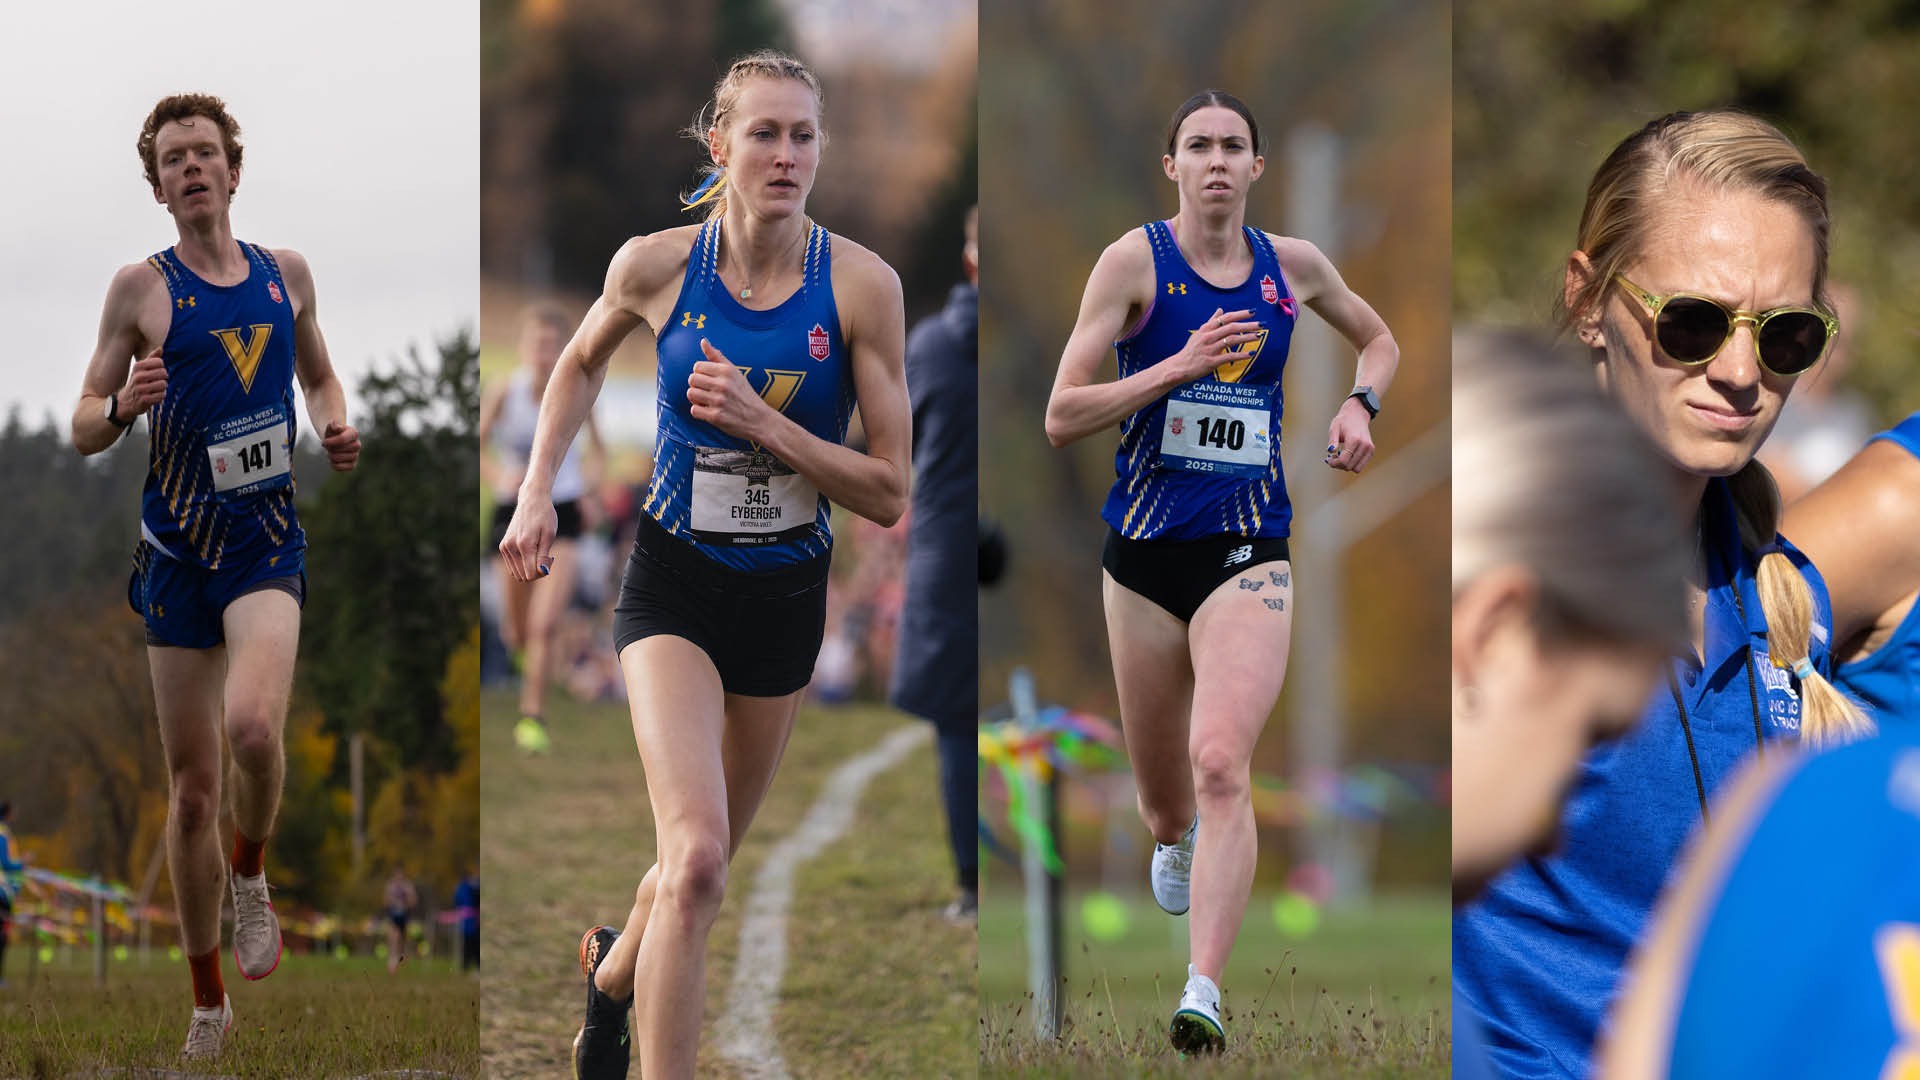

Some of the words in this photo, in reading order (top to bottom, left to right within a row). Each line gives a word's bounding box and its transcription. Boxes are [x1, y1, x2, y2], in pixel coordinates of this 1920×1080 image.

[811, 345, 829, 355] WEST
[208, 323, 273, 395] V
[1180, 389, 1193, 398] XC
[1195, 392, 1265, 406] CHAMPIONSHIPS
[1193, 383, 1232, 394] CANADA
[1235, 388, 1257, 397] WEST
[213, 431, 225, 441] XC
[225, 413, 284, 437] CHAMPIONSHIPS
[220, 415, 253, 431] CANADA
[254, 408, 274, 420] WEST
[1197, 417, 1245, 450] 140
[237, 440, 272, 474] 147
[1185, 460, 1214, 471] 2025
[236, 484, 260, 496] 2025
[745, 489, 770, 505] 345
[731, 505, 782, 520] EYBERGEN
